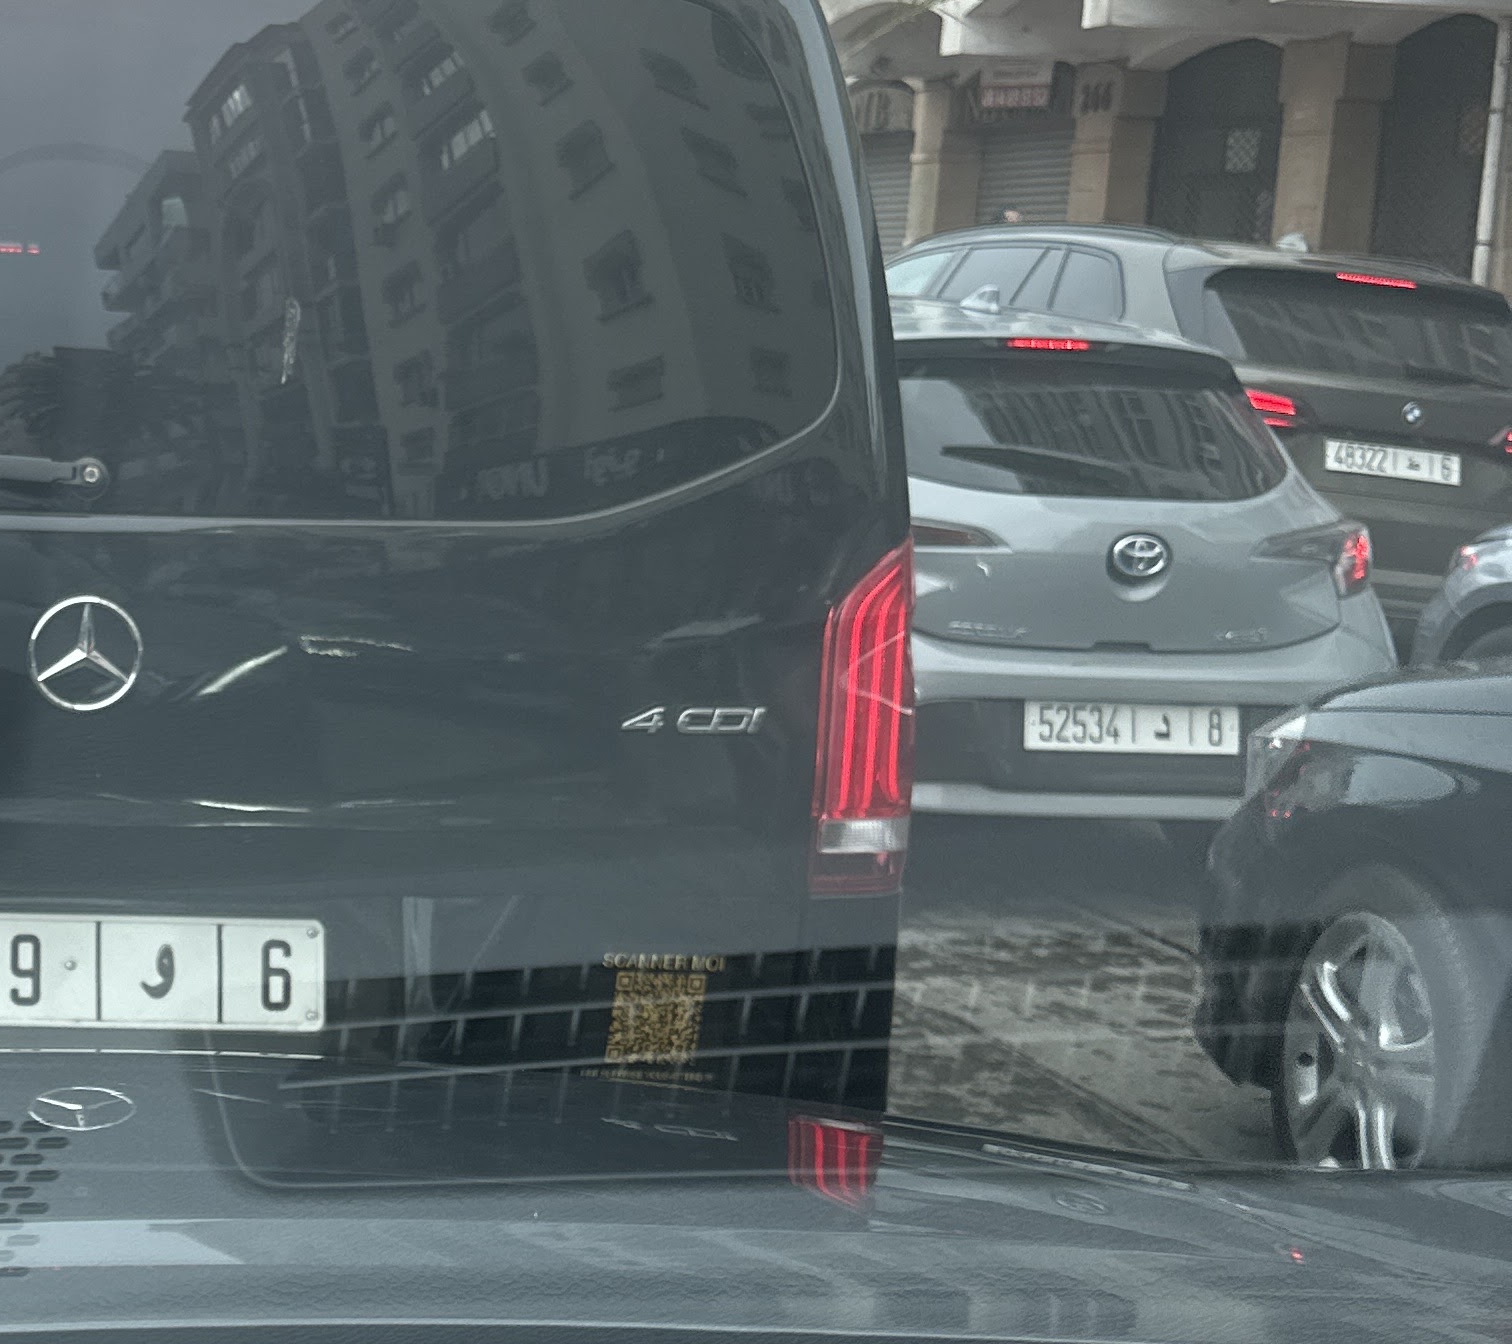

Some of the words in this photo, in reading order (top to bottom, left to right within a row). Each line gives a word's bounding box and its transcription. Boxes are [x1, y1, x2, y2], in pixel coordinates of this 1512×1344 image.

[621, 706, 666, 735] 4
[676, 706, 767, 735] CDI
[1038, 705, 1120, 745] 52534
[1208, 708, 1224, 747] 8
[141, 943, 176, 1000] و
[260, 938, 293, 1012] 6
[603, 952, 688, 971] SCANNER
[691, 955, 726, 972] MOI
